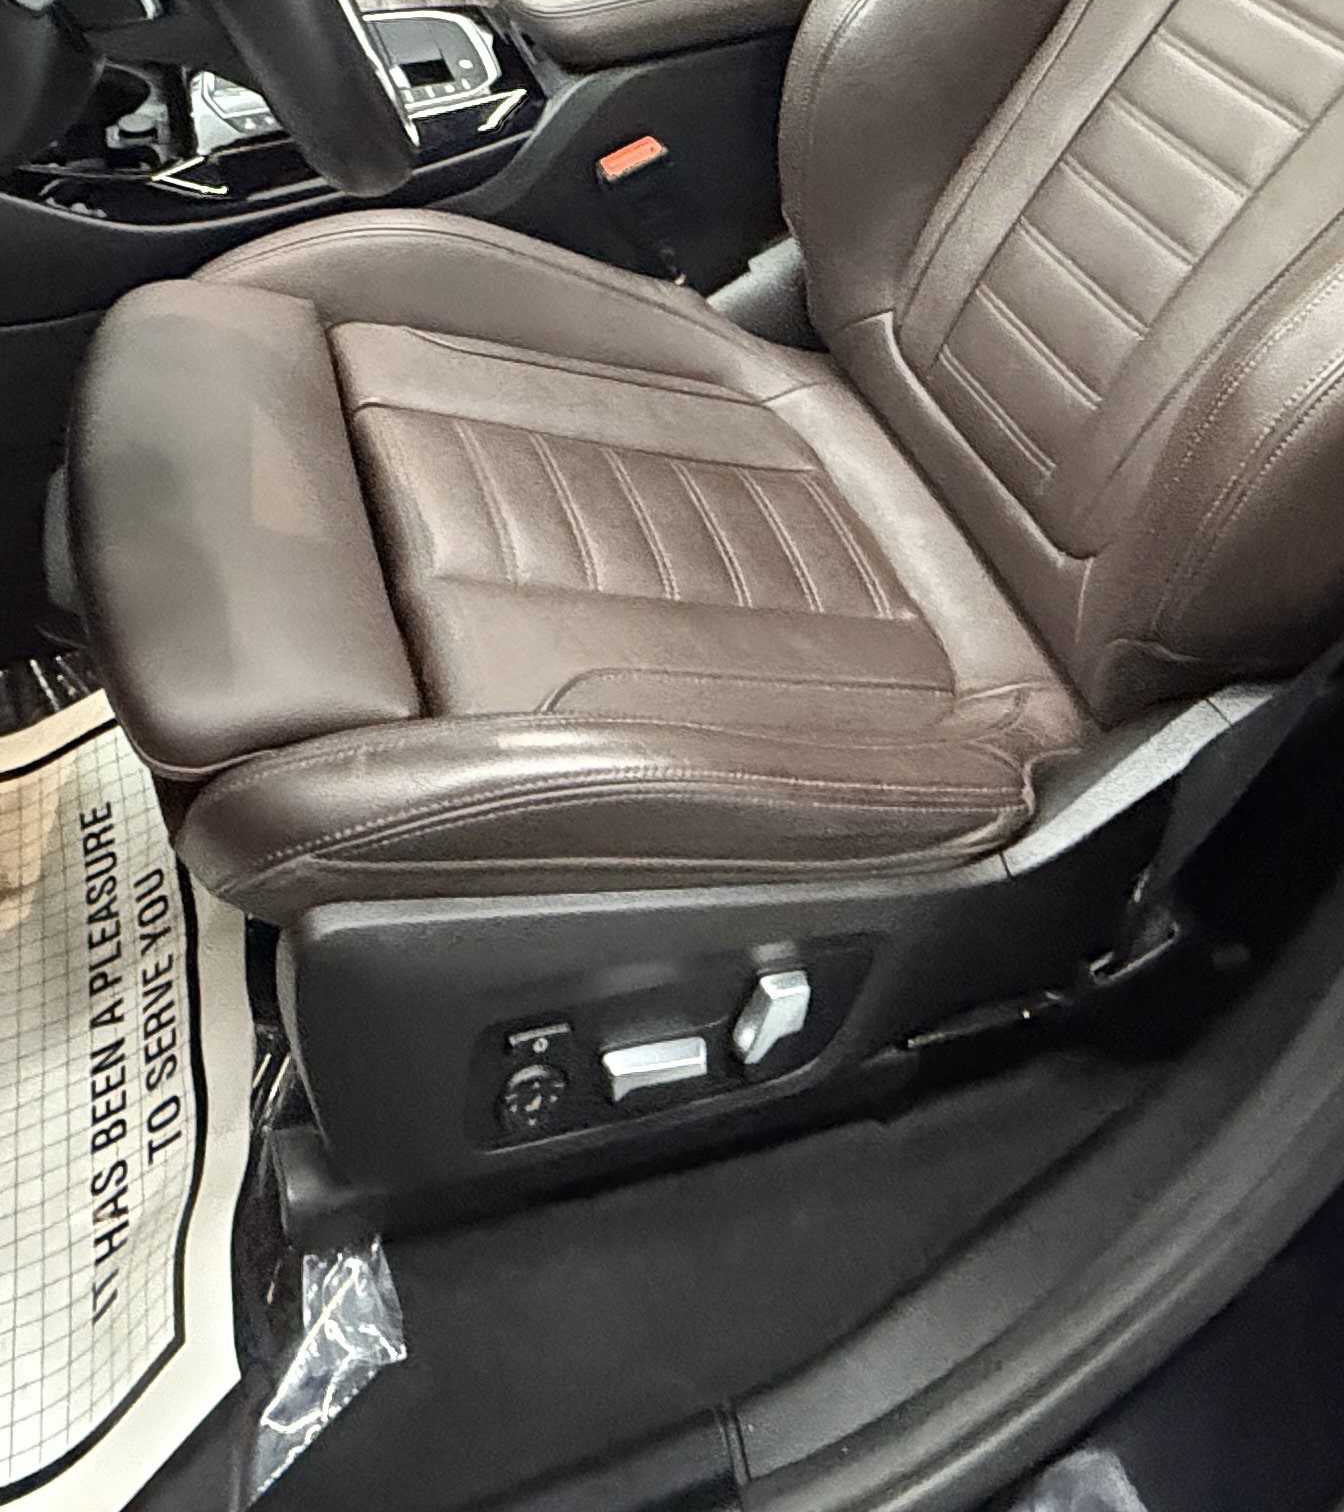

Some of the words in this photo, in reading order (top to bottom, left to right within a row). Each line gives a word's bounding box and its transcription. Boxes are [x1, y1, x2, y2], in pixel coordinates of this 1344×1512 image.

[80, 801, 122, 998] PLEASURE
[133, 868, 172, 955] YOU
[90, 997, 124, 1030] A
[142, 954, 177, 1092] SERVE
[90, 1036, 127, 1155] BEEN
[147, 1094, 182, 1165] TO
[91, 1159, 129, 1265] HAS
[92, 1268, 119, 1325] IT
